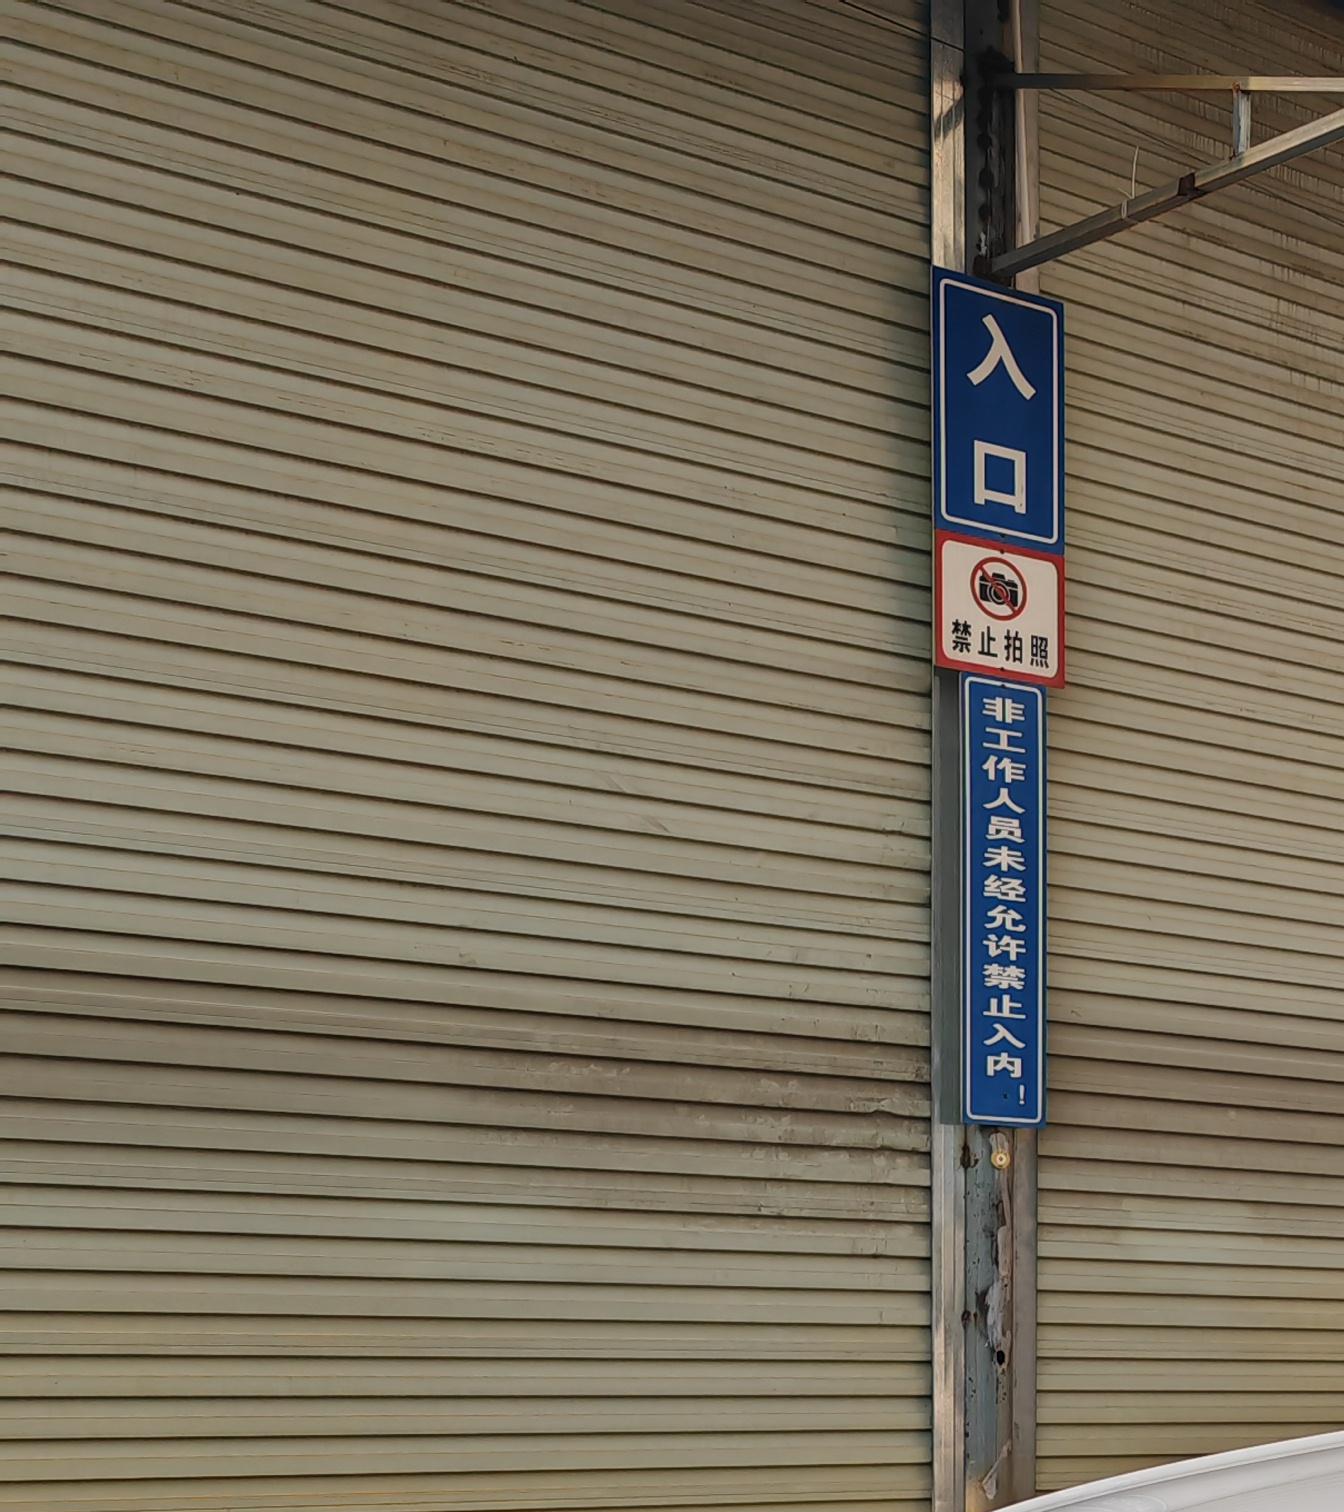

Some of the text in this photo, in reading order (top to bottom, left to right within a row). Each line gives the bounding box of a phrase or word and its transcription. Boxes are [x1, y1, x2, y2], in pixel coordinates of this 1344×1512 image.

[966, 313, 1037, 515] 入口
[951, 618, 1050, 669] 禁止拍照
